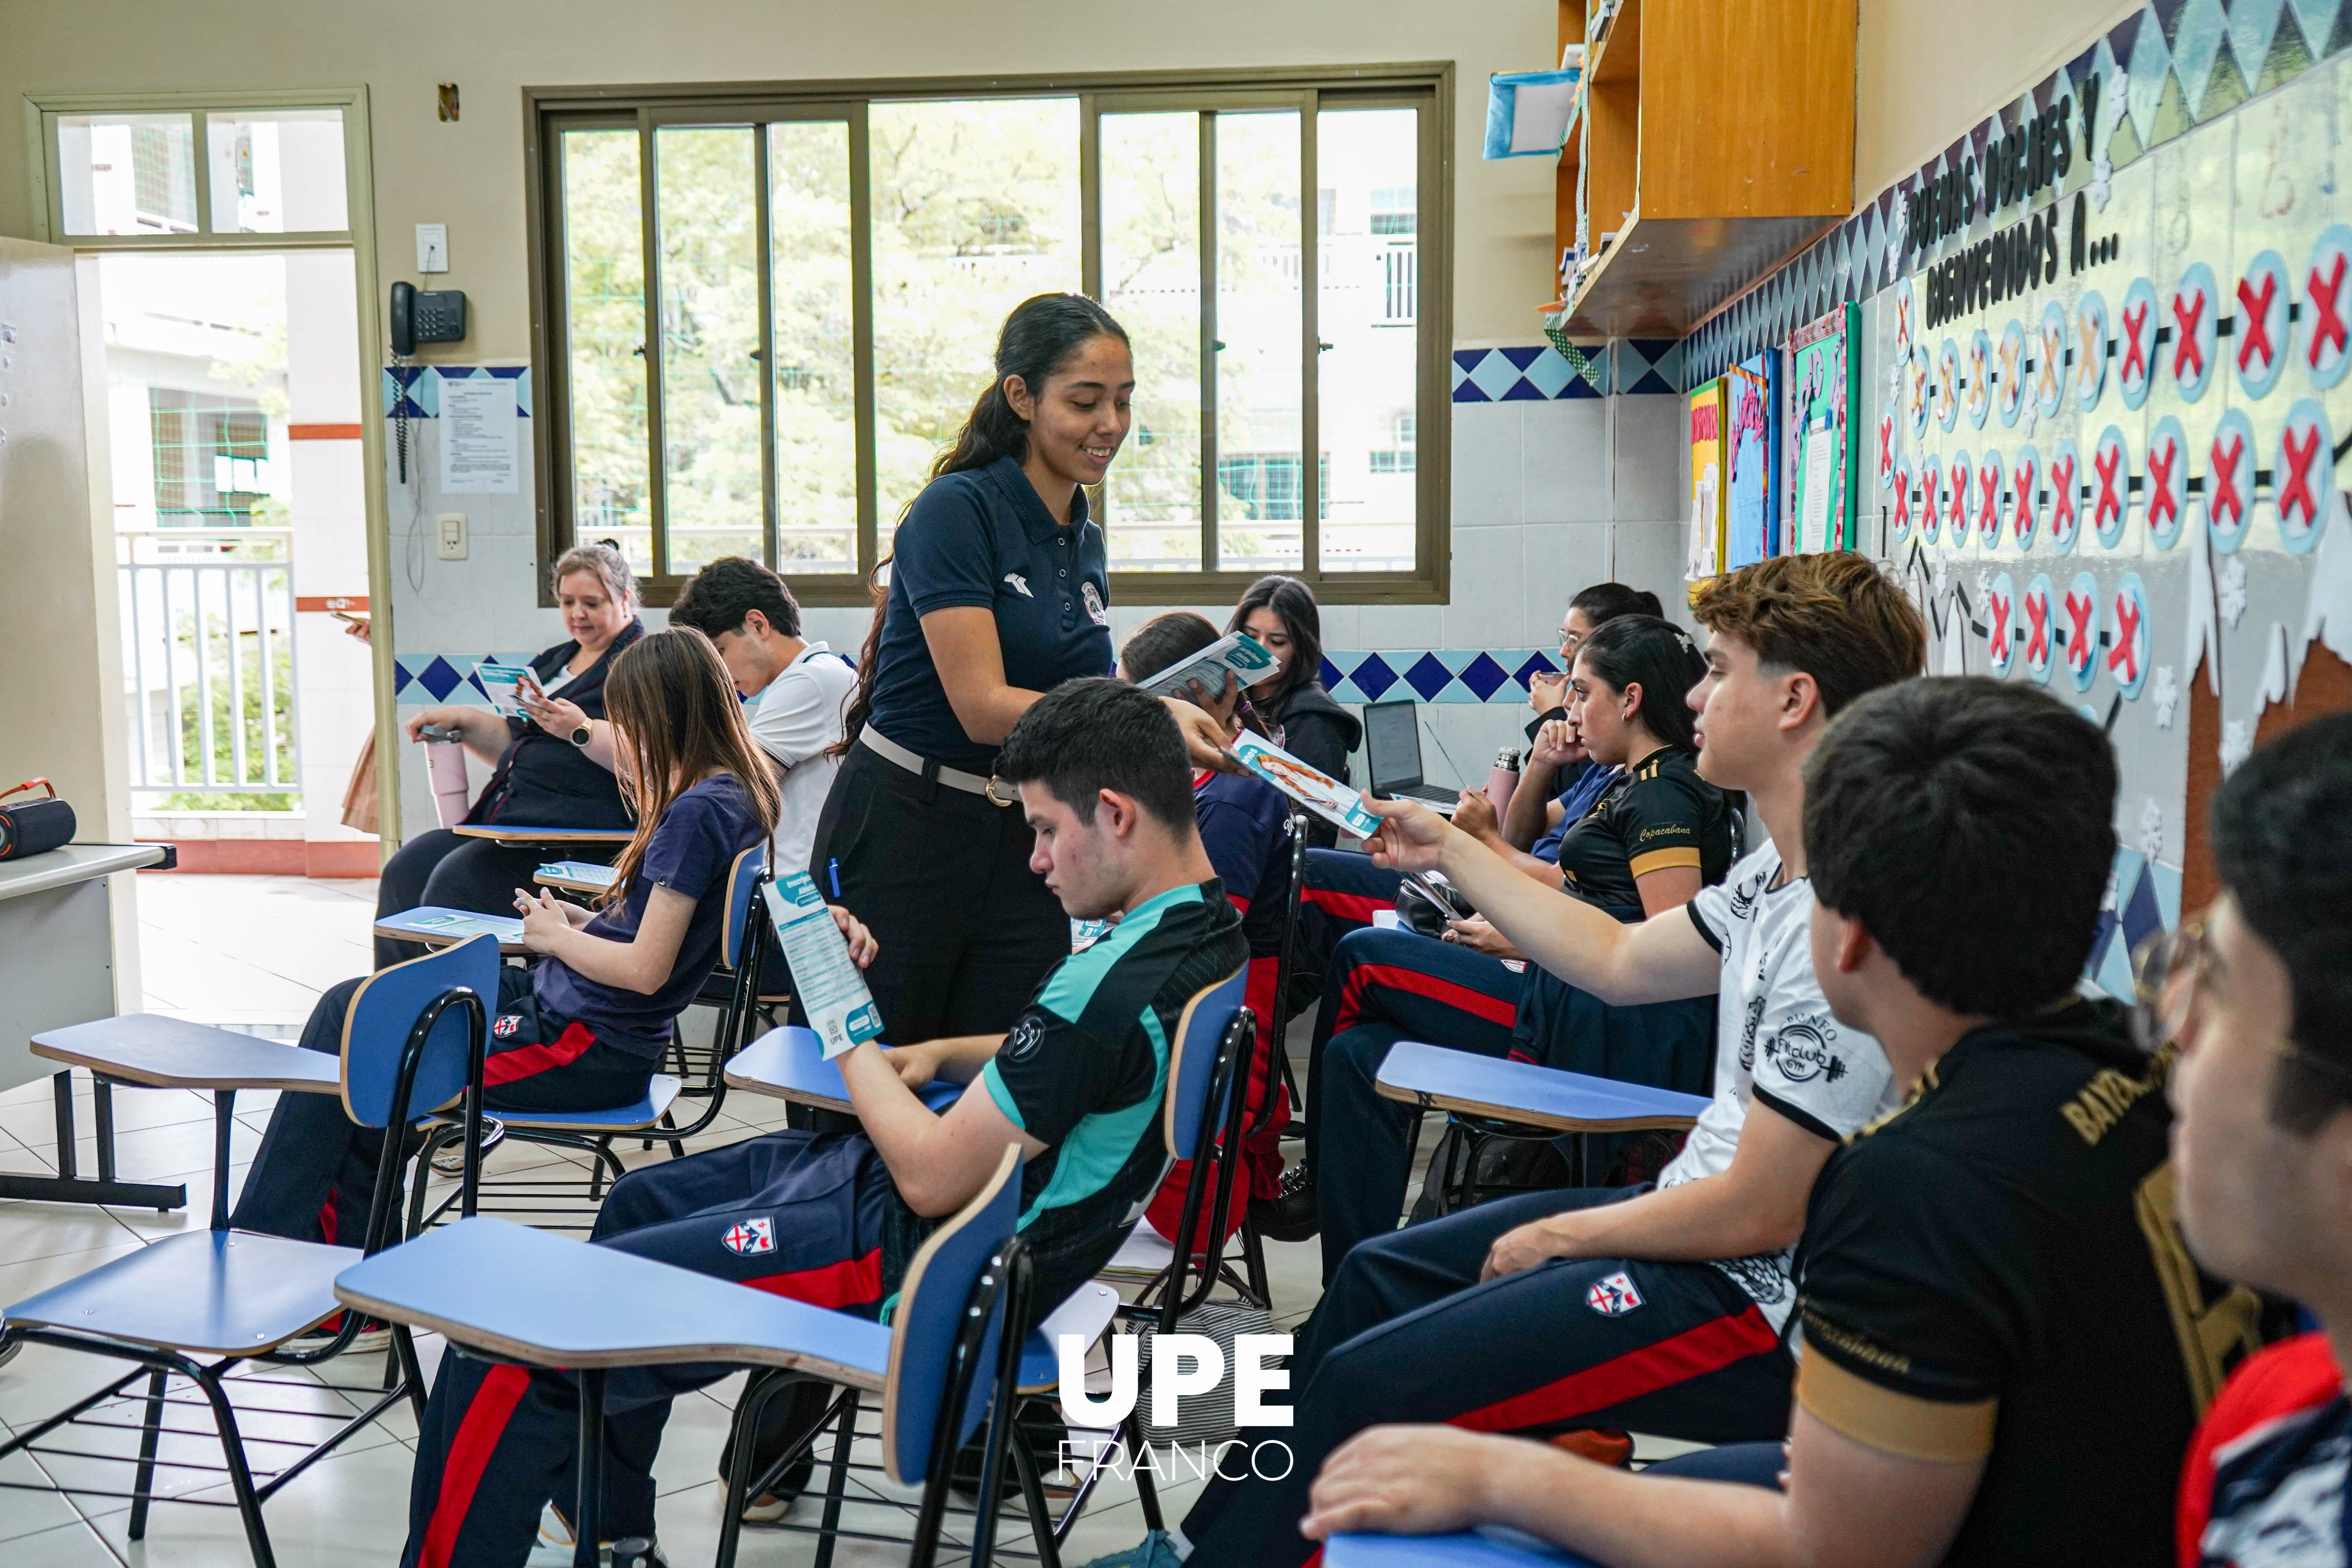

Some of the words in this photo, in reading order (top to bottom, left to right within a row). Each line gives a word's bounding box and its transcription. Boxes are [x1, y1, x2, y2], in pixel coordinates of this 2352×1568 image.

[1908, 156, 1975, 254] BUENAS
[1985, 94, 2071, 217] NOCHES
[2083, 71, 2101, 162] Y
[1927, 202, 2058, 330] BIENVENIDOS
[1640, 824, 1691, 842] Copacabana
[830, 1034, 844, 1045] UPE
[1786, 1059, 1806, 1073] GYM
